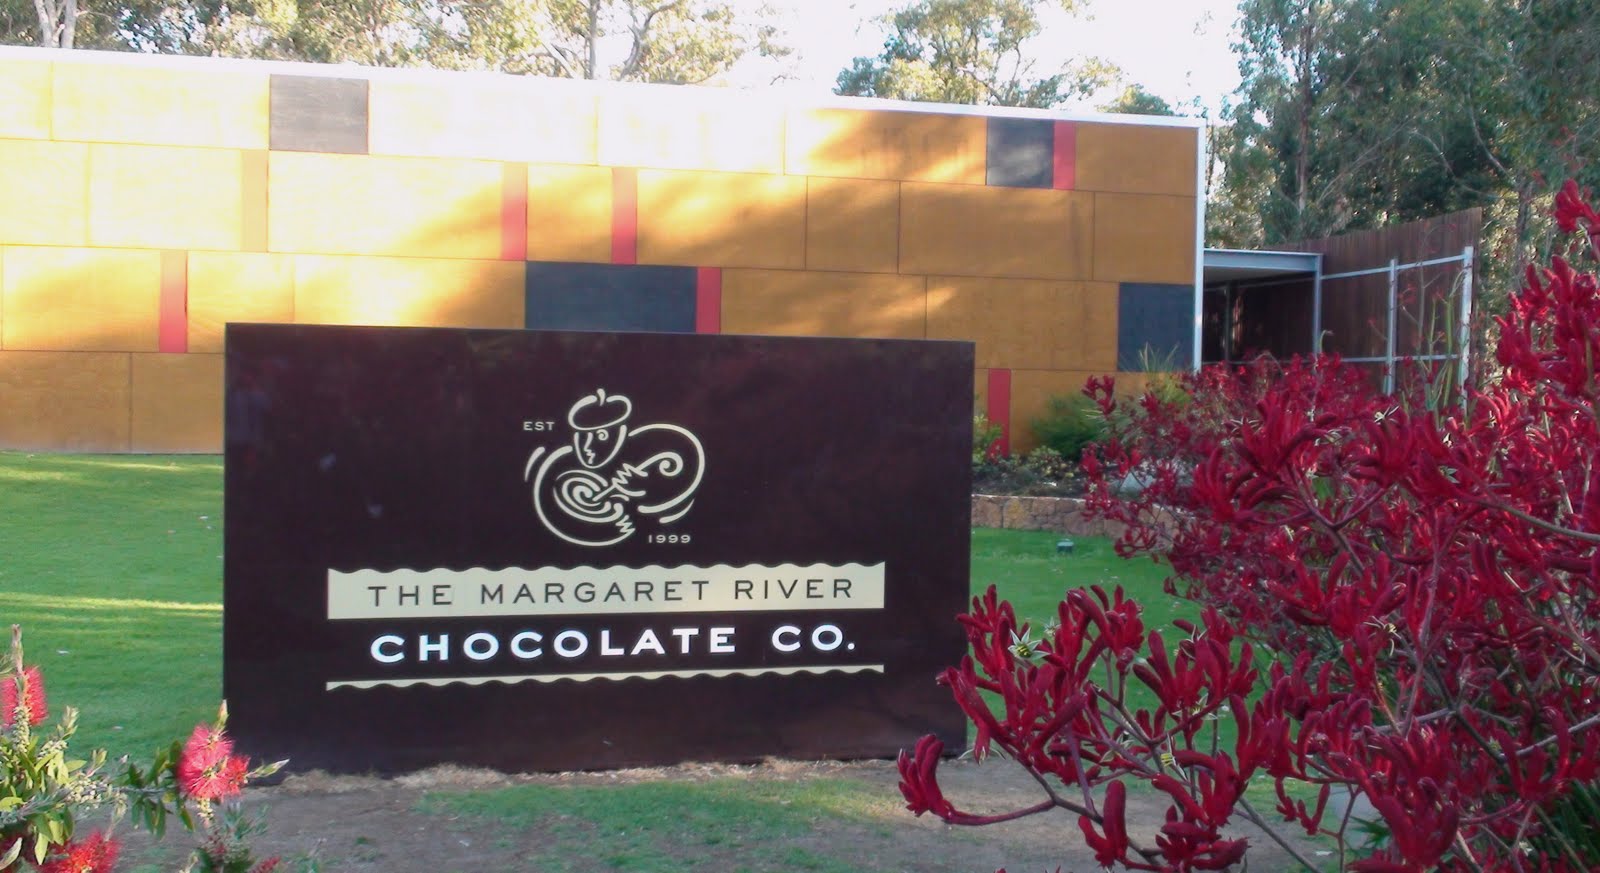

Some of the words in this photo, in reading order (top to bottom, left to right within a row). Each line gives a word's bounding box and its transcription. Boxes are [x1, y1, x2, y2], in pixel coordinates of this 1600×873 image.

[523, 421, 555, 431] EST
[648, 534, 691, 544] 1999
[367, 584, 452, 607] THE
[481, 580, 709, 604] MARGARET
[734, 578, 852, 600] RIVER
[370, 626, 736, 664] CHOCOLATE
[771, 624, 855, 652] CO.
